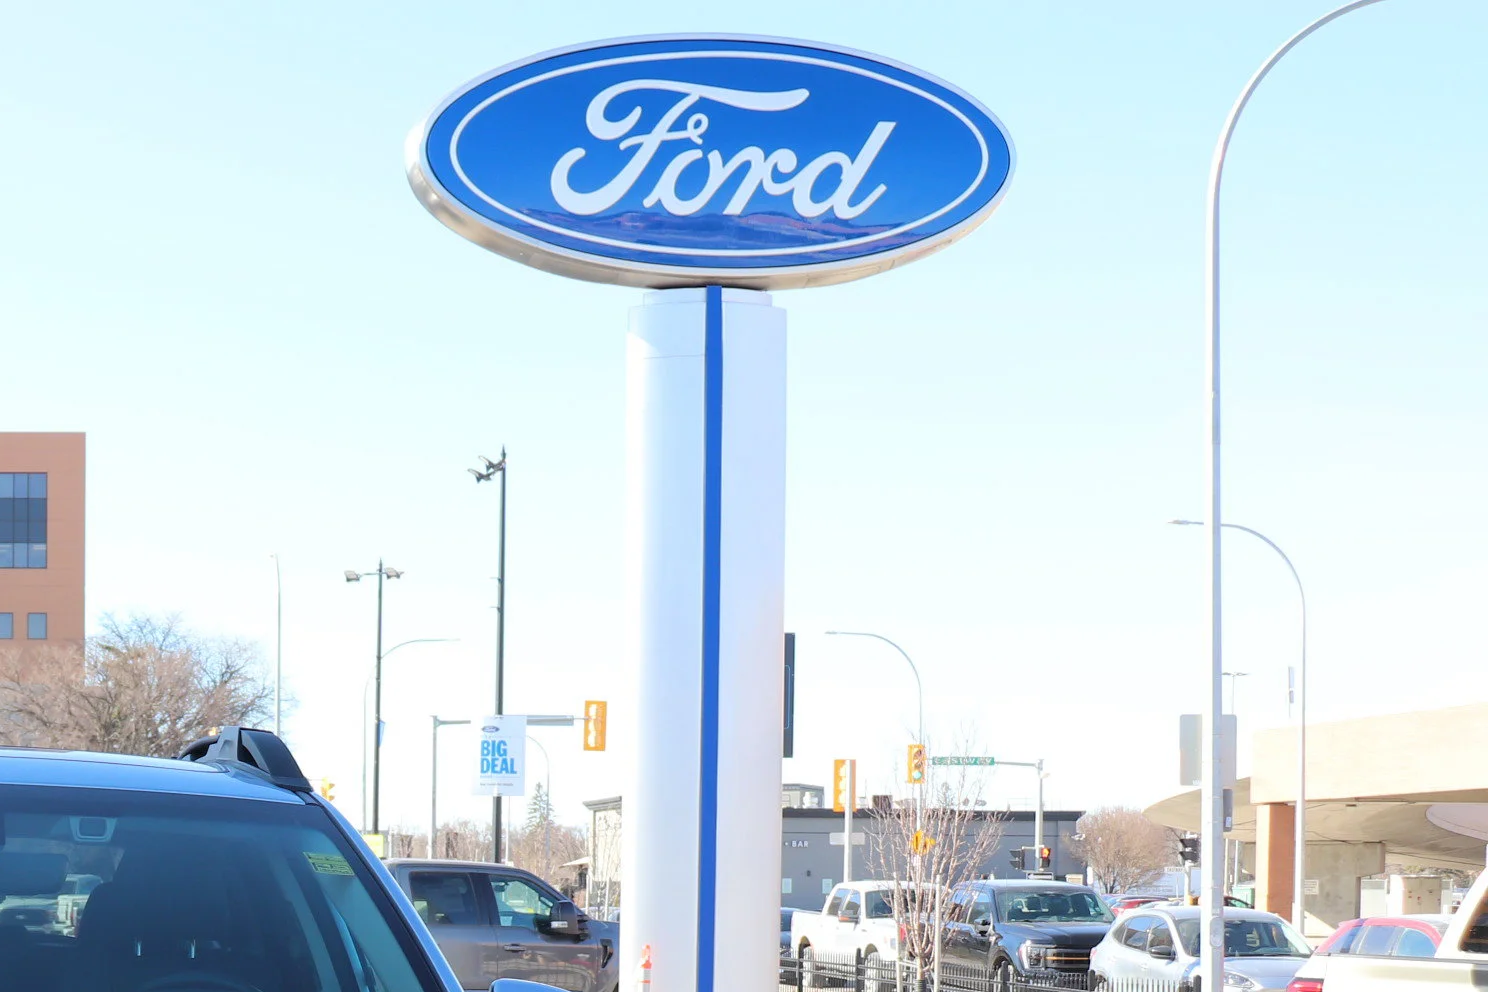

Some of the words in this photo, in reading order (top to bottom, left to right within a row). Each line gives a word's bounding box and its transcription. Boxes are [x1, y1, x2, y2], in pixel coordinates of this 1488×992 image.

[550, 78, 896, 219] Ford
[480, 740, 508, 757] BIG
[480, 757, 518, 775] DEAL
[792, 840, 809, 848] BAR
